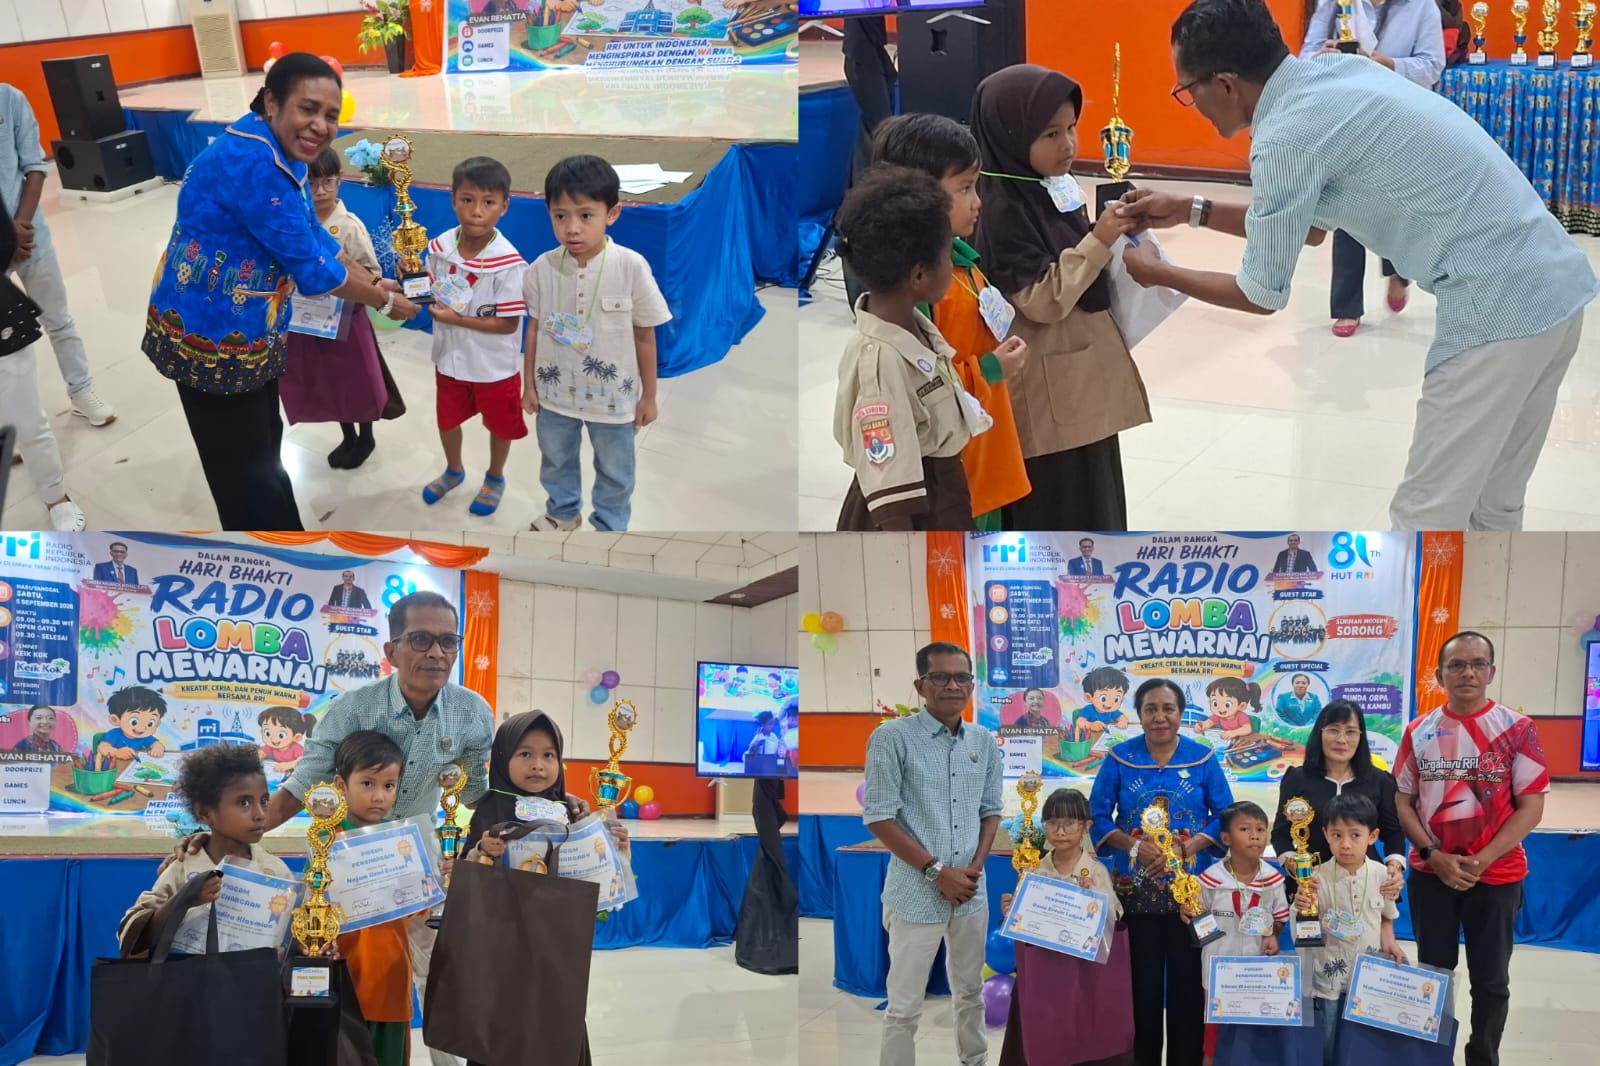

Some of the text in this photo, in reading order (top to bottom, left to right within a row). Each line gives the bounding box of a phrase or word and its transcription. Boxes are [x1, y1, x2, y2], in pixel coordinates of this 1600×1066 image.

[469, 12, 527, 24] EVAN REHATTA
[656, 39, 710, 48] INDONESIA,
[588, 48, 733, 60] MENGINSPIRASI DENGAN WARNA
[0, 532, 40, 560] ri
[46, 542, 72, 550] RADIO
[982, 538, 1026, 562] rri
[1136, 544, 1239, 560] HARI BHAKTI
[46, 548, 86, 559] REPUBLIK
[198, 552, 271, 567] DALAM RANGKA
[1370, 550, 1381, 558] Th
[45, 555, 92, 566] INDONESIA
[179, 560, 292, 586] HARI BHAKTI
[1330, 572, 1352, 580] HUT
[1113, 561, 1260, 600] RADIO
[21, 599, 58, 608] SEPTEMBER
[150, 574, 314, 622] RADIO
[1117, 600, 1256, 634] LOMBA
[1336, 626, 1383, 636] SORONG
[155, 617, 312, 662] LOMBA
[1105, 630, 1271, 662] MEWARNAI
[16, 662, 62, 674] Keik Kok
[138, 652, 327, 692] MEWARNAI
[212, 684, 233, 692] CERIA,
[274, 690, 296, 700] WARNA
[218, 692, 251, 701] BERSAMA
[1368, 694, 1388, 702] ORPA
[200, 723, 216, 732] rri
[26, 753, 74, 762] REHATTA
[1420, 757, 1478, 772] Dirgahayu RRI
